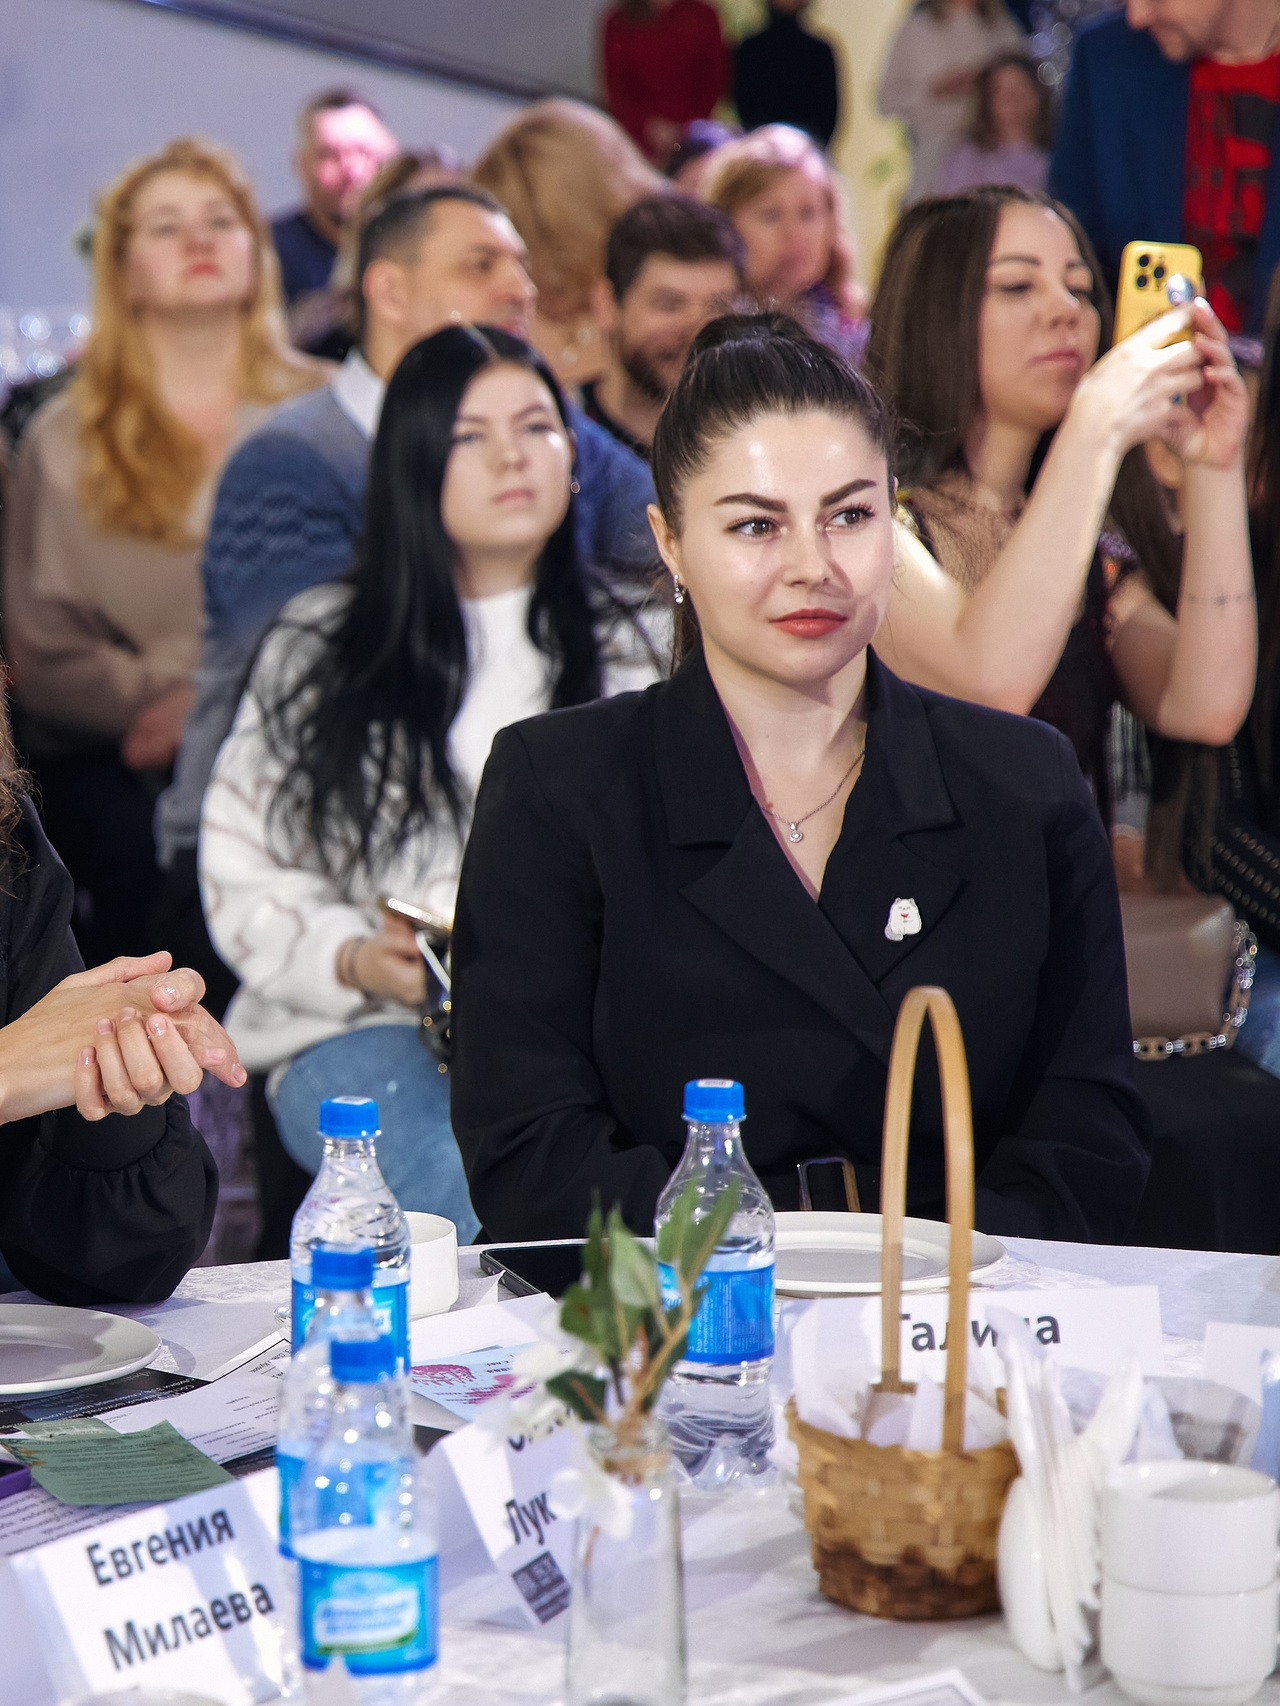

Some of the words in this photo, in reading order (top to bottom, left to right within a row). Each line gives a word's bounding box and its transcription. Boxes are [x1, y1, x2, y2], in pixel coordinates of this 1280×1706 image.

[898, 1313, 1062, 1352] аиа
[86, 1508, 235, 1587] Евгения
[505, 1491, 558, 1546] Лук
[104, 1583, 275, 1672] Милаева
